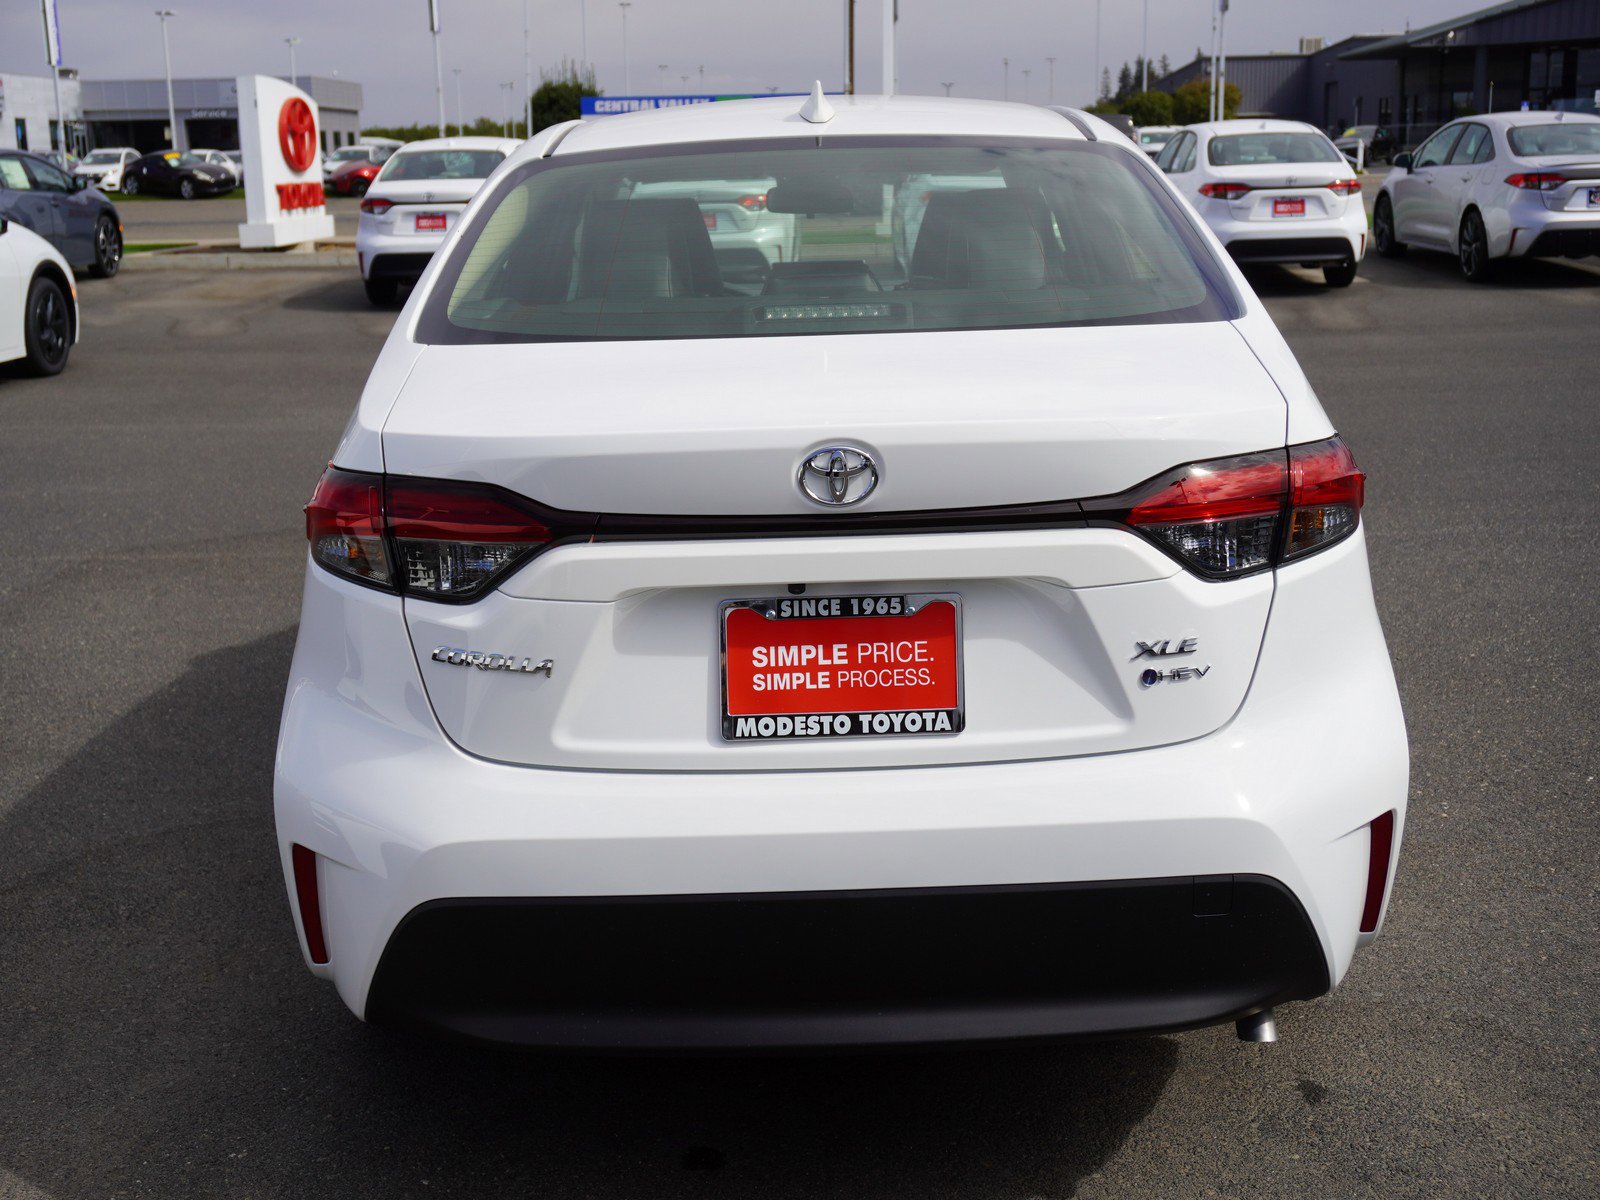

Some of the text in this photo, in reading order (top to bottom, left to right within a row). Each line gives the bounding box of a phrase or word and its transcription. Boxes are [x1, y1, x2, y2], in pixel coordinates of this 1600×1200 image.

[594, 99, 656, 113] CENTRAL
[780, 598, 902, 617] SINCE 1965
[431, 645, 553, 678] COROLLA
[752, 640, 935, 667] SIMPLE PRICE.
[1128, 638, 1198, 662] XLE
[752, 668, 936, 691] SIMPLE PROCESS.
[735, 711, 952, 738] MODESTO TOYOTA
